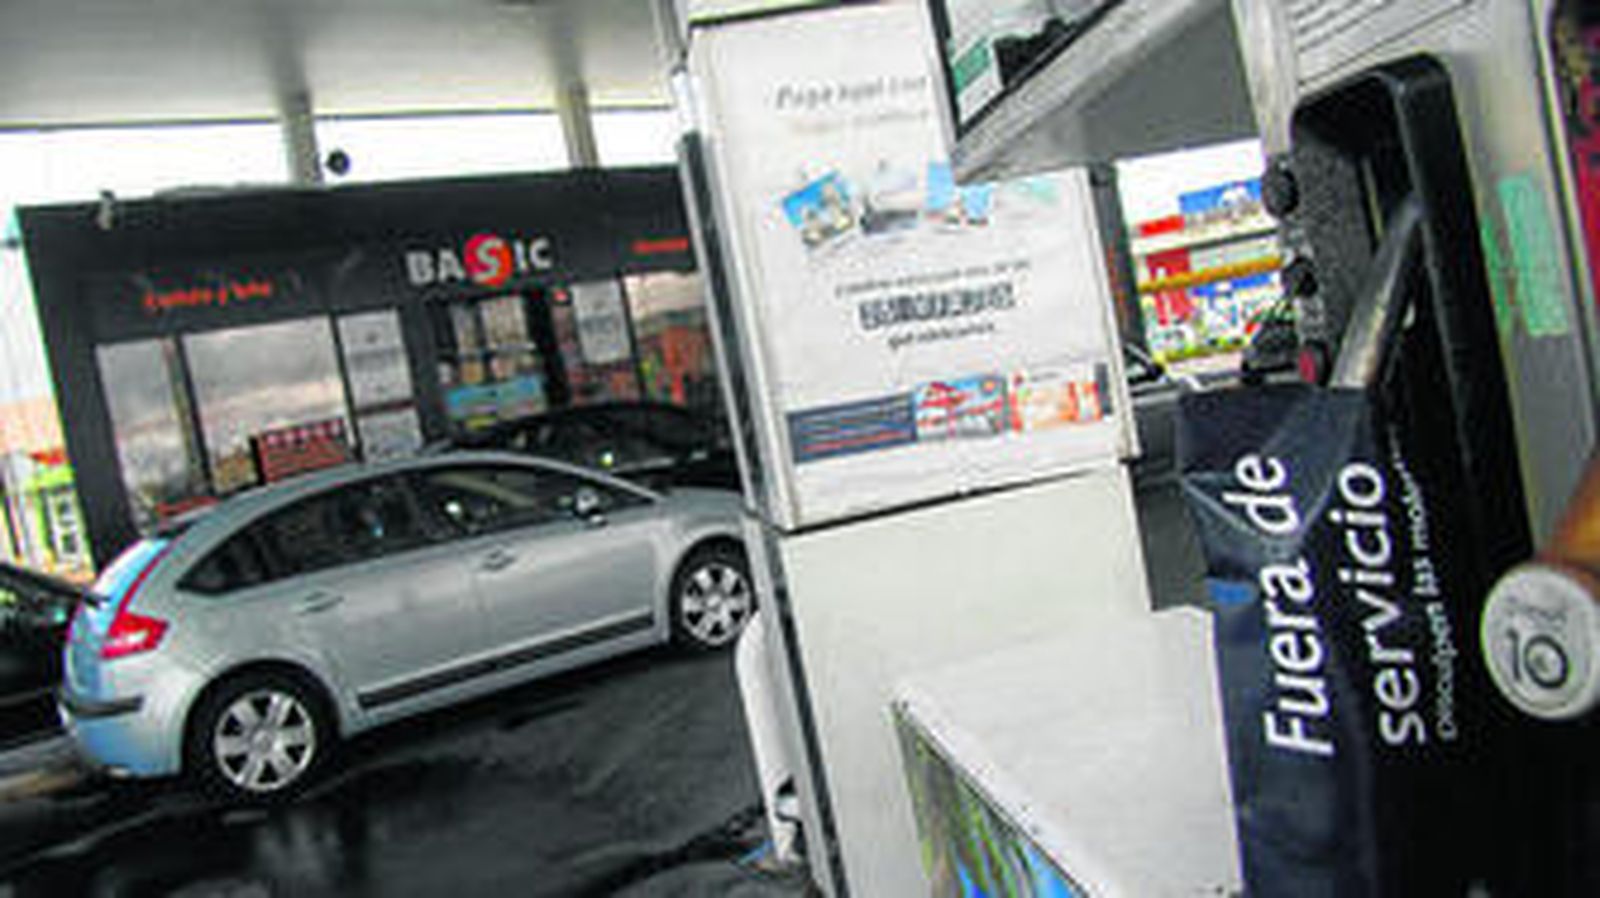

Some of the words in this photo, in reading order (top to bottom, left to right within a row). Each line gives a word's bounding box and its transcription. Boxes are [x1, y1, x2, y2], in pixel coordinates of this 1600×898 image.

[405, 234, 553, 286] BASIC
[1221, 454, 1299, 535] de
[1259, 556, 1335, 756] Fuera
[1329, 462, 1427, 745] servicio
